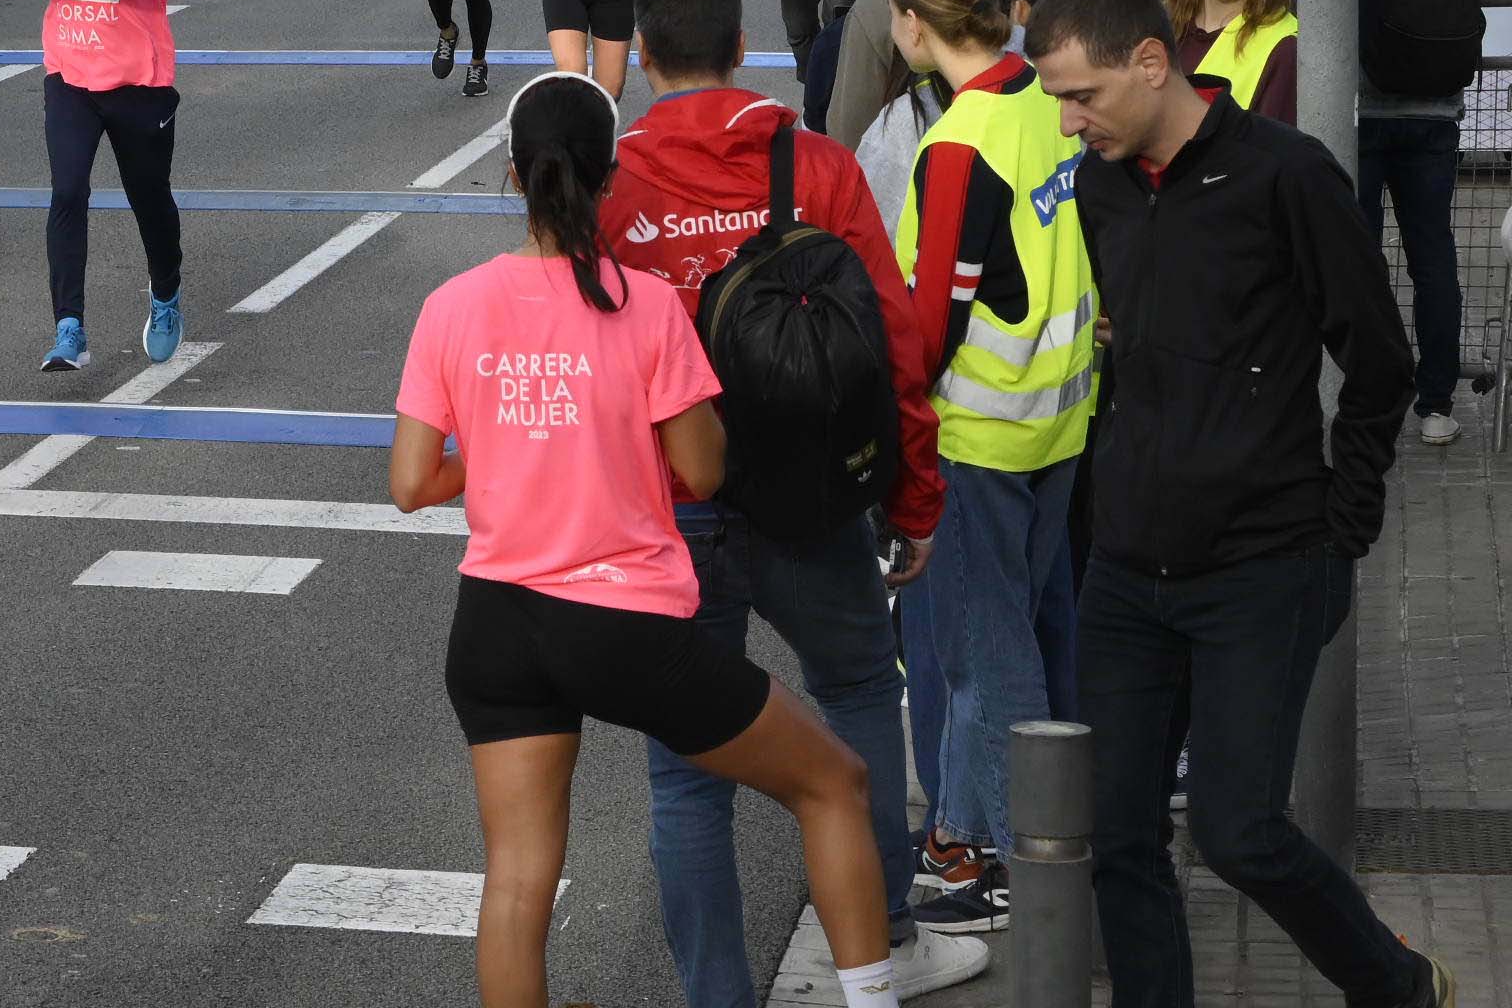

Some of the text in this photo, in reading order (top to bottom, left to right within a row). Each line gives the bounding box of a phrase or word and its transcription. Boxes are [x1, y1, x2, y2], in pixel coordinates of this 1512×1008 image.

[476, 353, 592, 377] CARRERA
[500, 378, 571, 401] DE LA
[496, 403, 580, 426] MUJER
